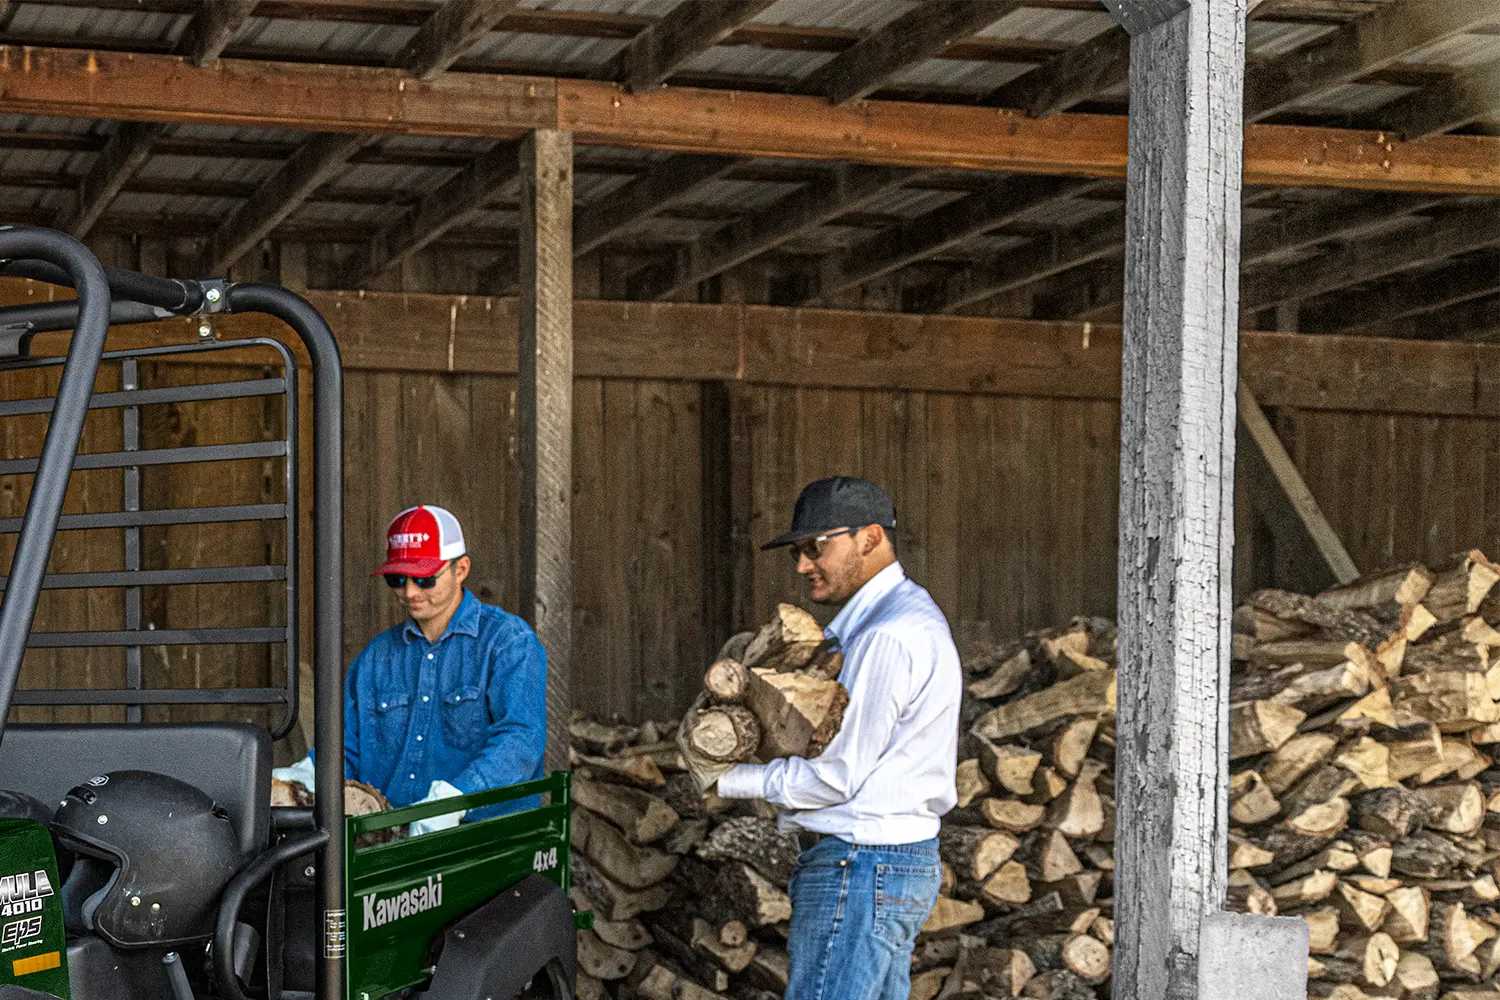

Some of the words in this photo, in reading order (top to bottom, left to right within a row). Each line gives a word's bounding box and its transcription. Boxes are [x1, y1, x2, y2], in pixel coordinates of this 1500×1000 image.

[1, 898, 43, 917] 4010
[362, 873, 443, 931] Kawasaki
[1, 915, 43, 945] EPS
